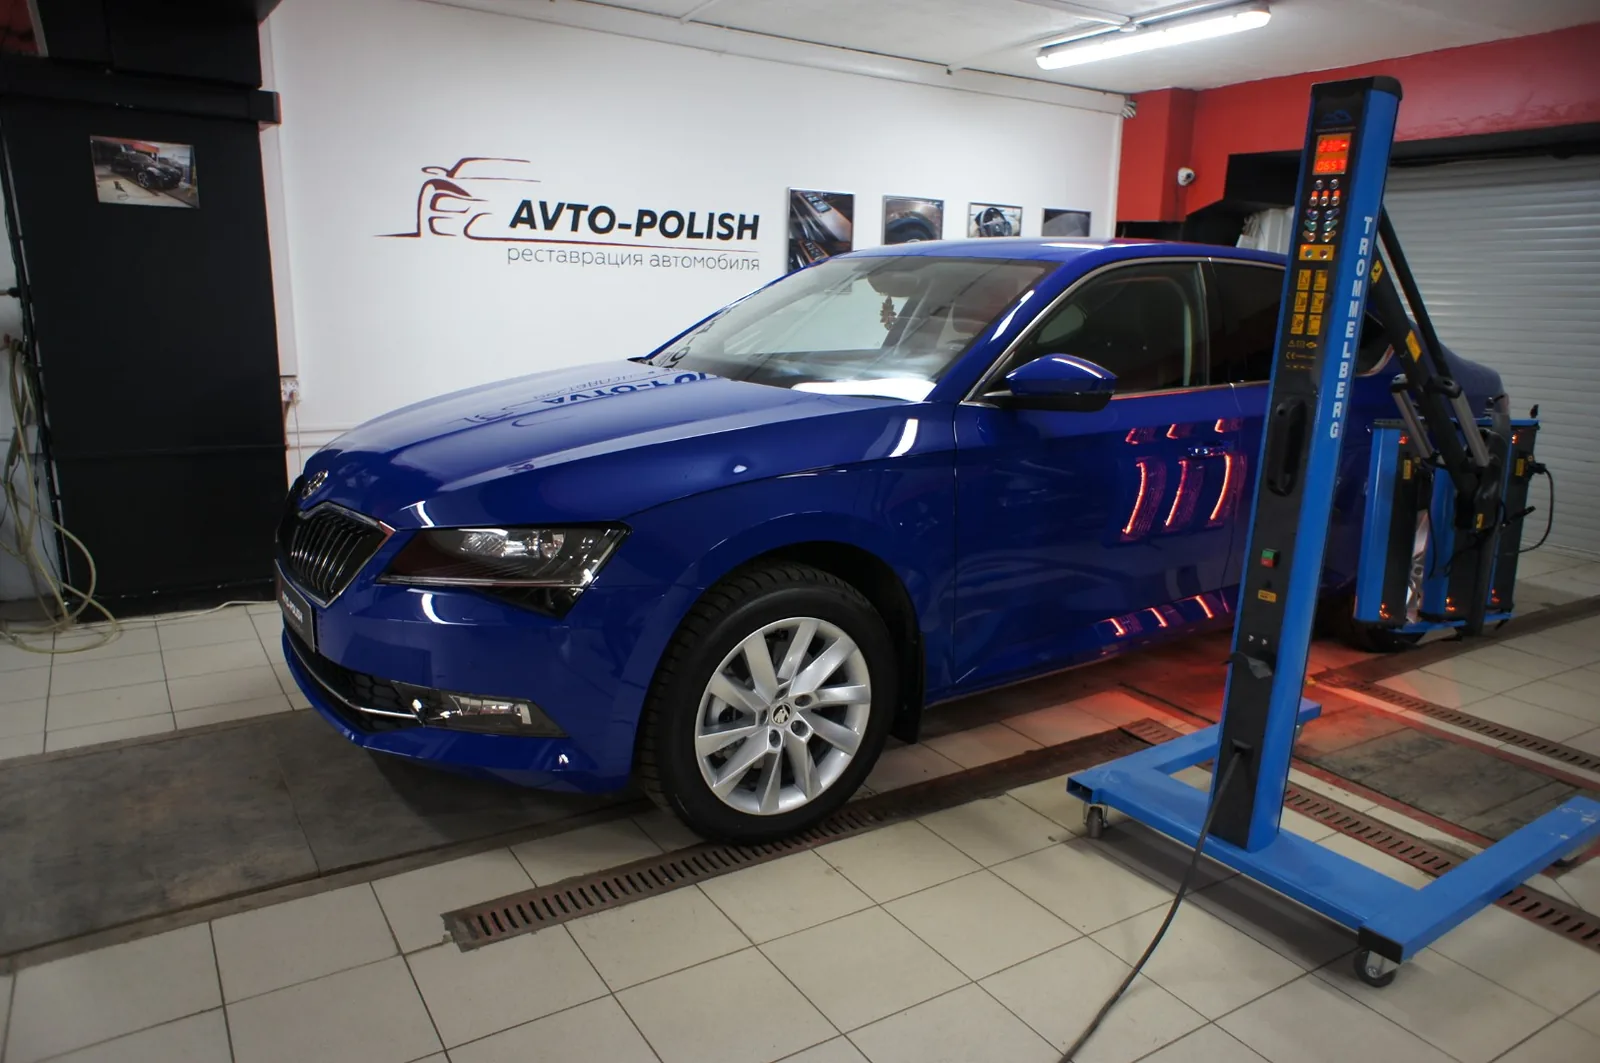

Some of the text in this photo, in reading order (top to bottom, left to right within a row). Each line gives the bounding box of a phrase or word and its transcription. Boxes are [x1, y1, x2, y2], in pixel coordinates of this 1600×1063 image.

[509, 199, 760, 241] AVTO-POLISH
[507, 247, 760, 271] реставрация автомобиля
[1330, 216, 1373, 439] TROMMELBERG
